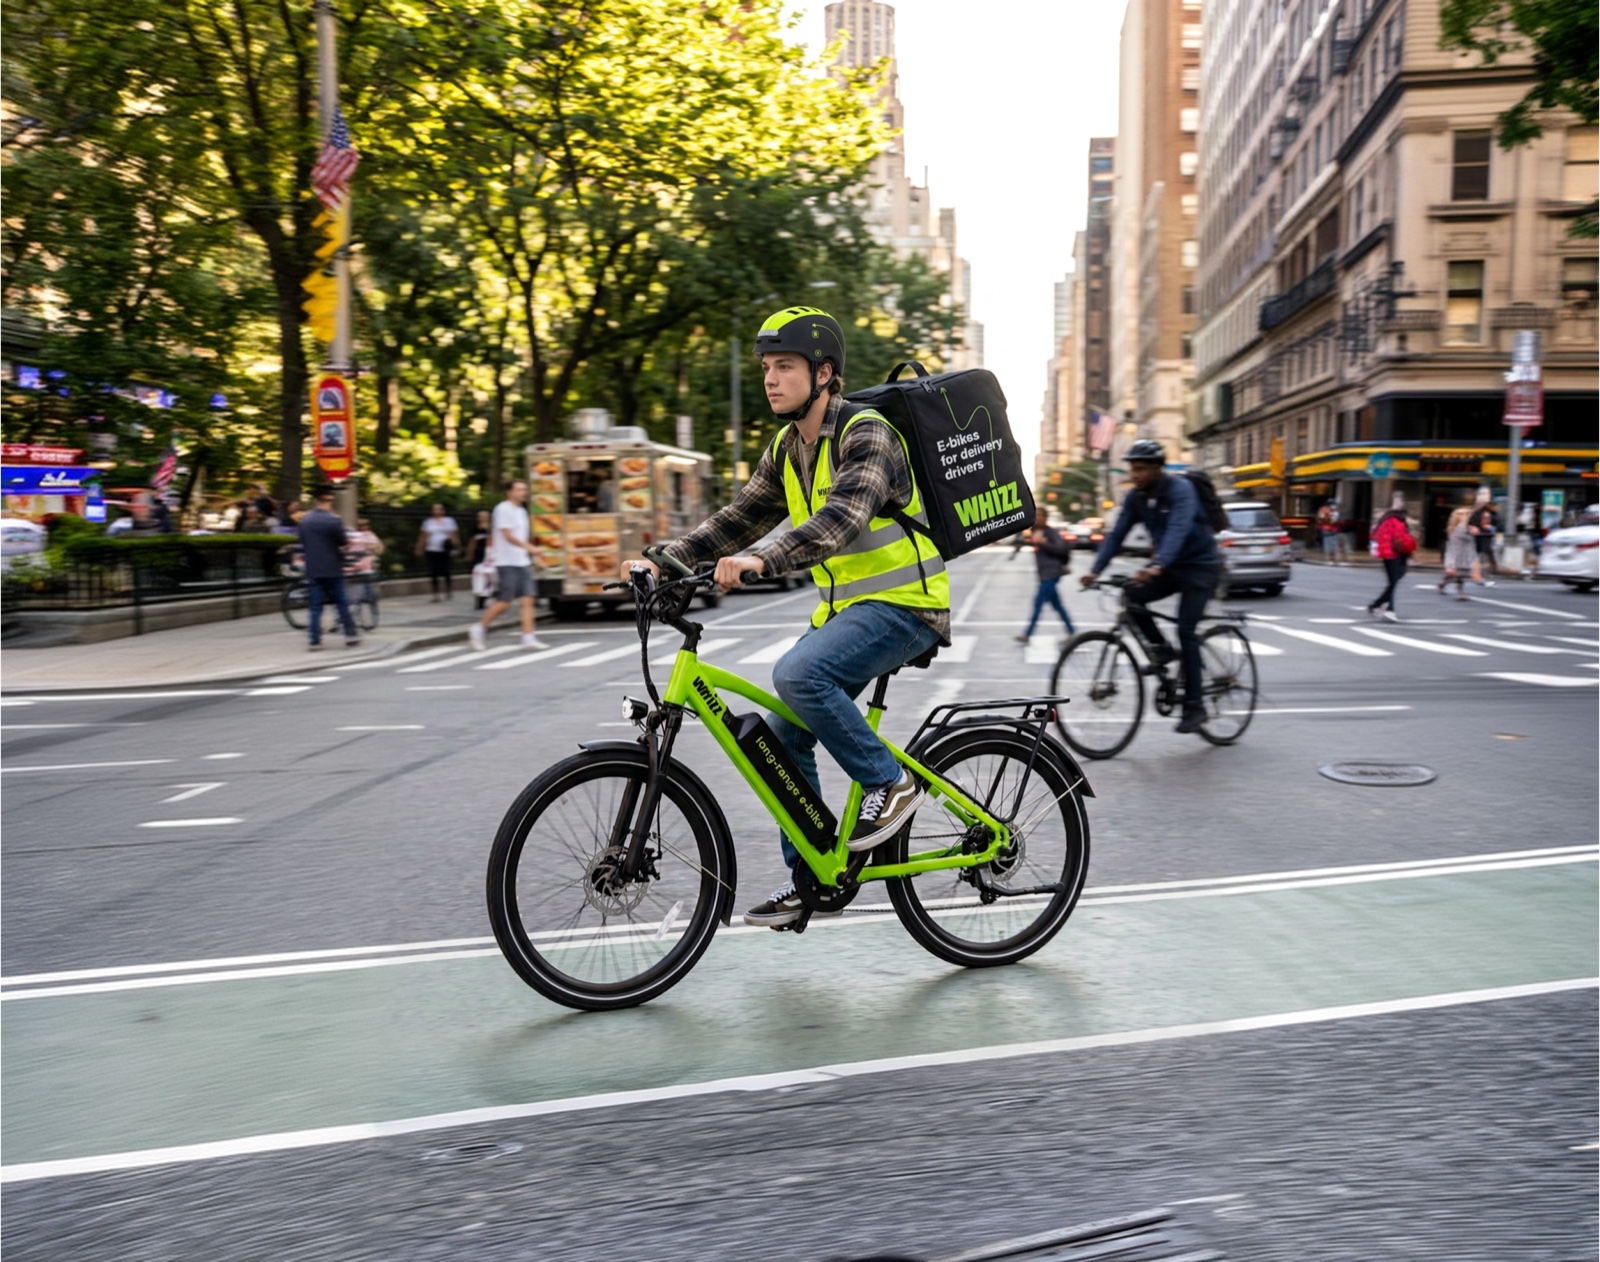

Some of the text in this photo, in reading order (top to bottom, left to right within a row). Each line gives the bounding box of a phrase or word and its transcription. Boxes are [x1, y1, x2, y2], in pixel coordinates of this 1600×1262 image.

[936, 431, 980, 452] E-bikes
[940, 453, 958, 467] for
[945, 460, 984, 480] drivers
[964, 511, 1025, 542] getwhizz.com
